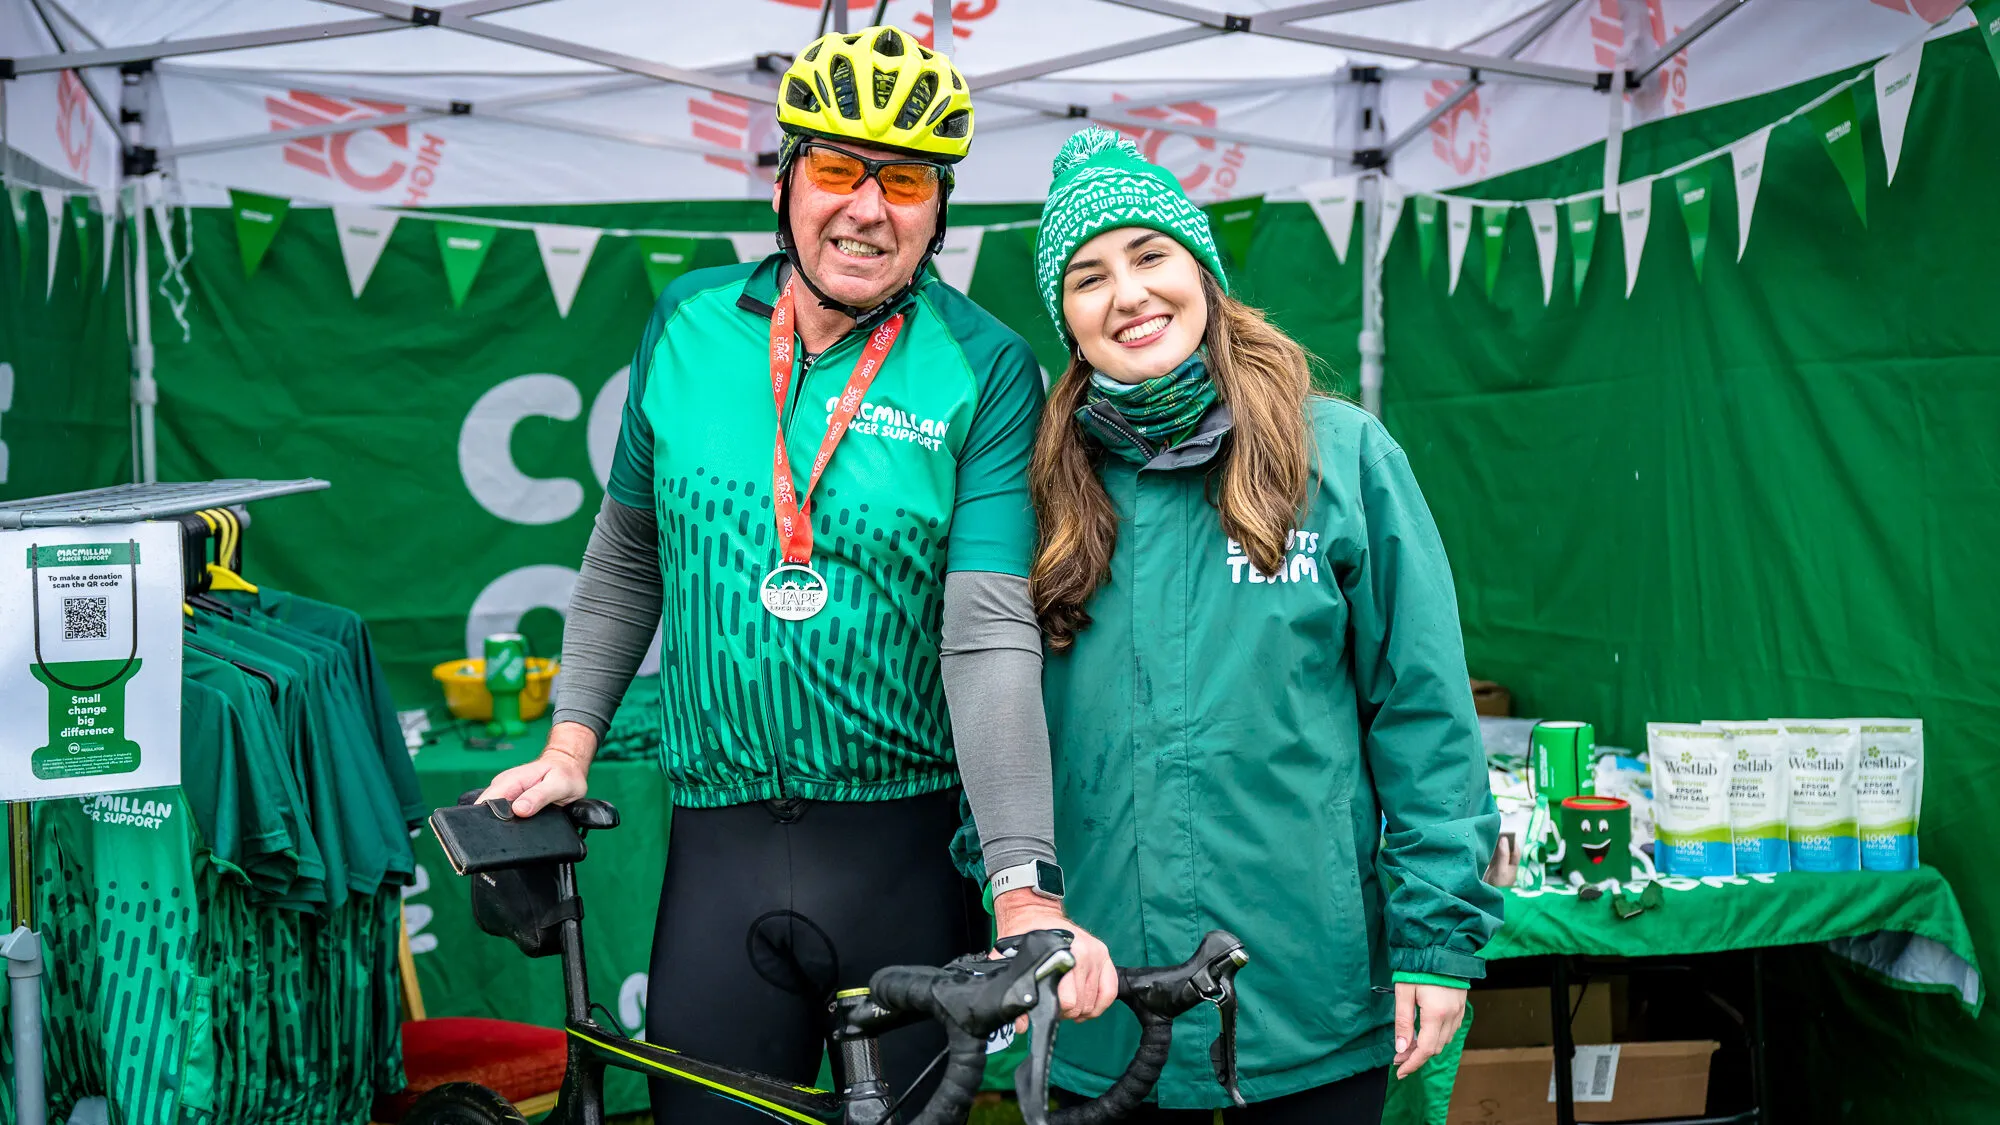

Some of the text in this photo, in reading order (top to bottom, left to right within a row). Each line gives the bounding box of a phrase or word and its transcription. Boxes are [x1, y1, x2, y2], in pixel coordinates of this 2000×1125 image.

[1049, 186, 1148, 241] MACMILLAN
[1054, 196, 1149, 250] CANCER SUPPORT
[860, 359, 876, 378] 2023
[882, 425, 942, 452] SUPPORT
[784, 516, 793, 538] 2023
[57, 548, 112, 558] MACMILLAN
[88, 572, 122, 580] donation
[72, 580, 85, 588] the
[86, 580, 98, 588] QR
[766, 591, 821, 606] ETAPE
[72, 694, 100, 704] Small
[68, 706, 107, 716] change
[78, 716, 94, 726] big
[60, 727, 114, 738] difference
[1664, 760, 1718, 776] Westlab
[1733, 760, 1773, 772] estlab
[1789, 756, 1844, 771] Westlab
[103, 812, 163, 830] SUPPORT
[1676, 839, 1704, 850] 100%
[1736, 836, 1761, 847] 00%
[1801, 834, 1832, 845] 100%
[1866, 834, 1896, 844] 100%
